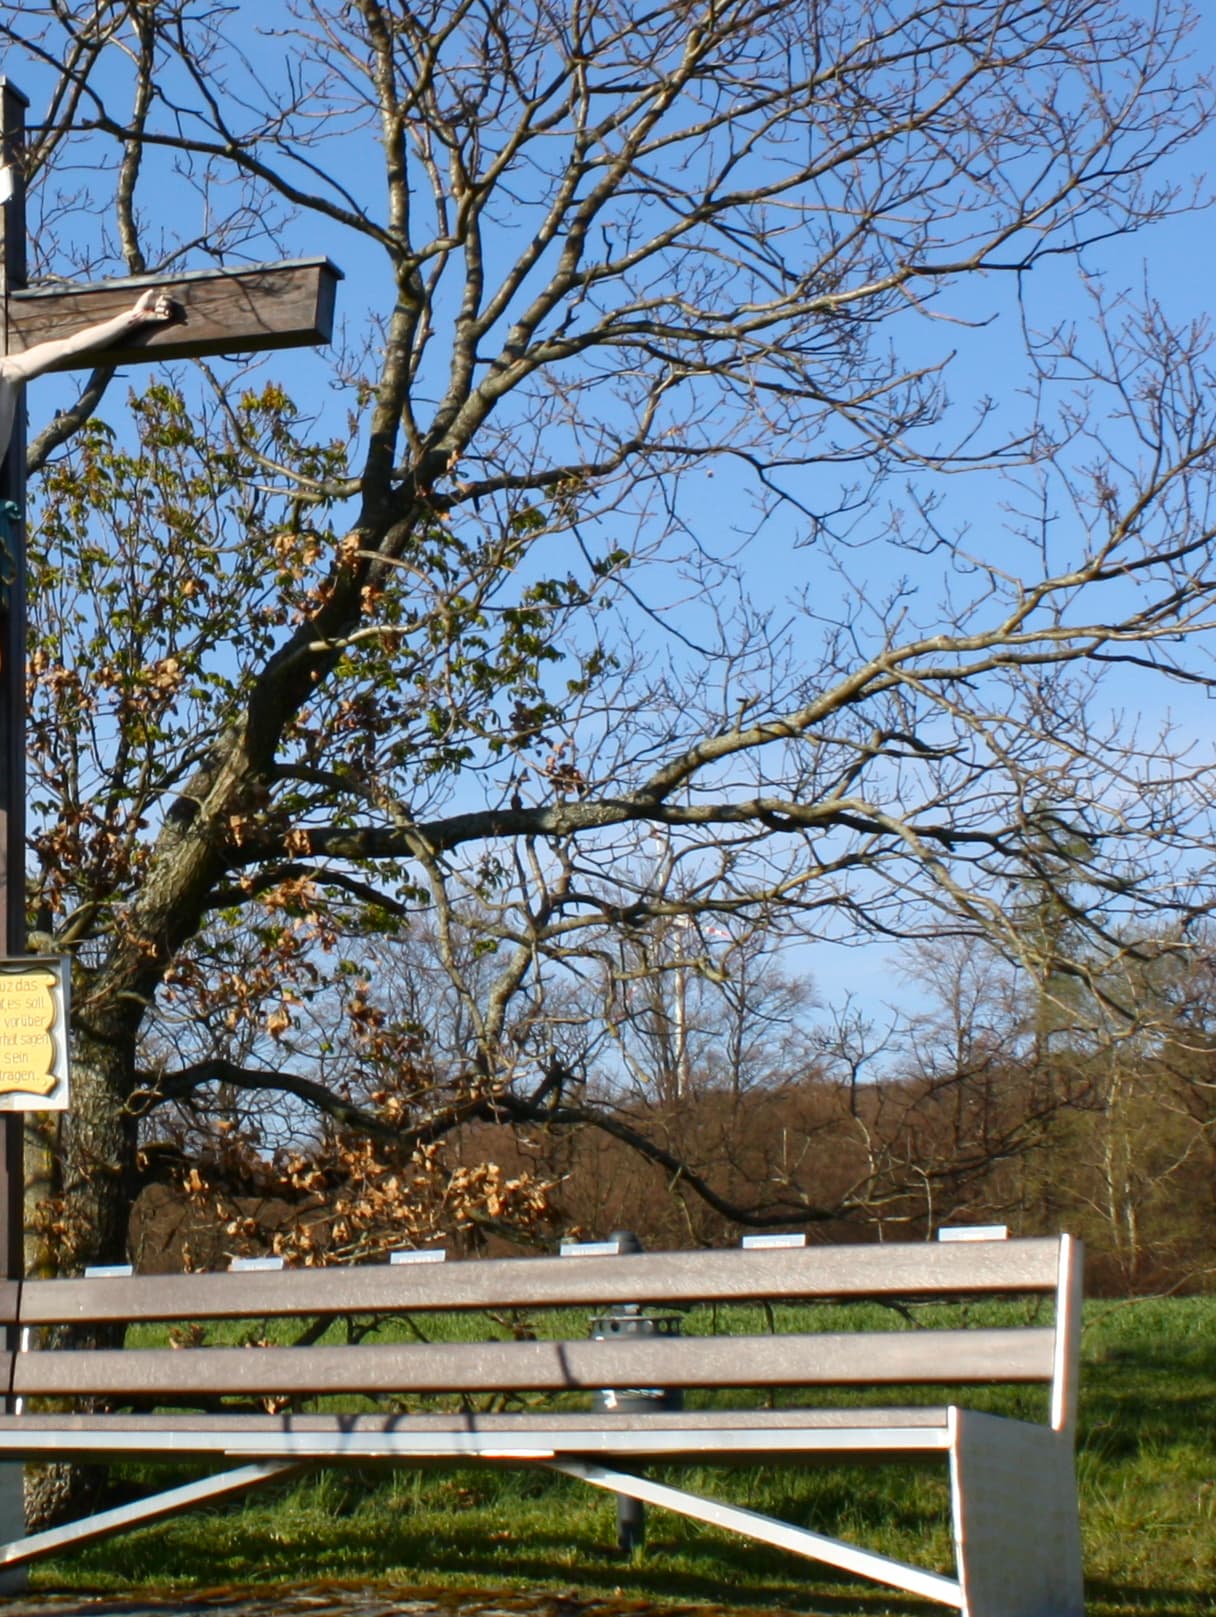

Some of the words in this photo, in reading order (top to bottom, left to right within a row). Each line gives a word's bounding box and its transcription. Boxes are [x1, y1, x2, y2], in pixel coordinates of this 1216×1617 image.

[15, 979, 38, 992] das
[24, 995, 45, 1008] soll
[3, 1050, 29, 1064] sein
